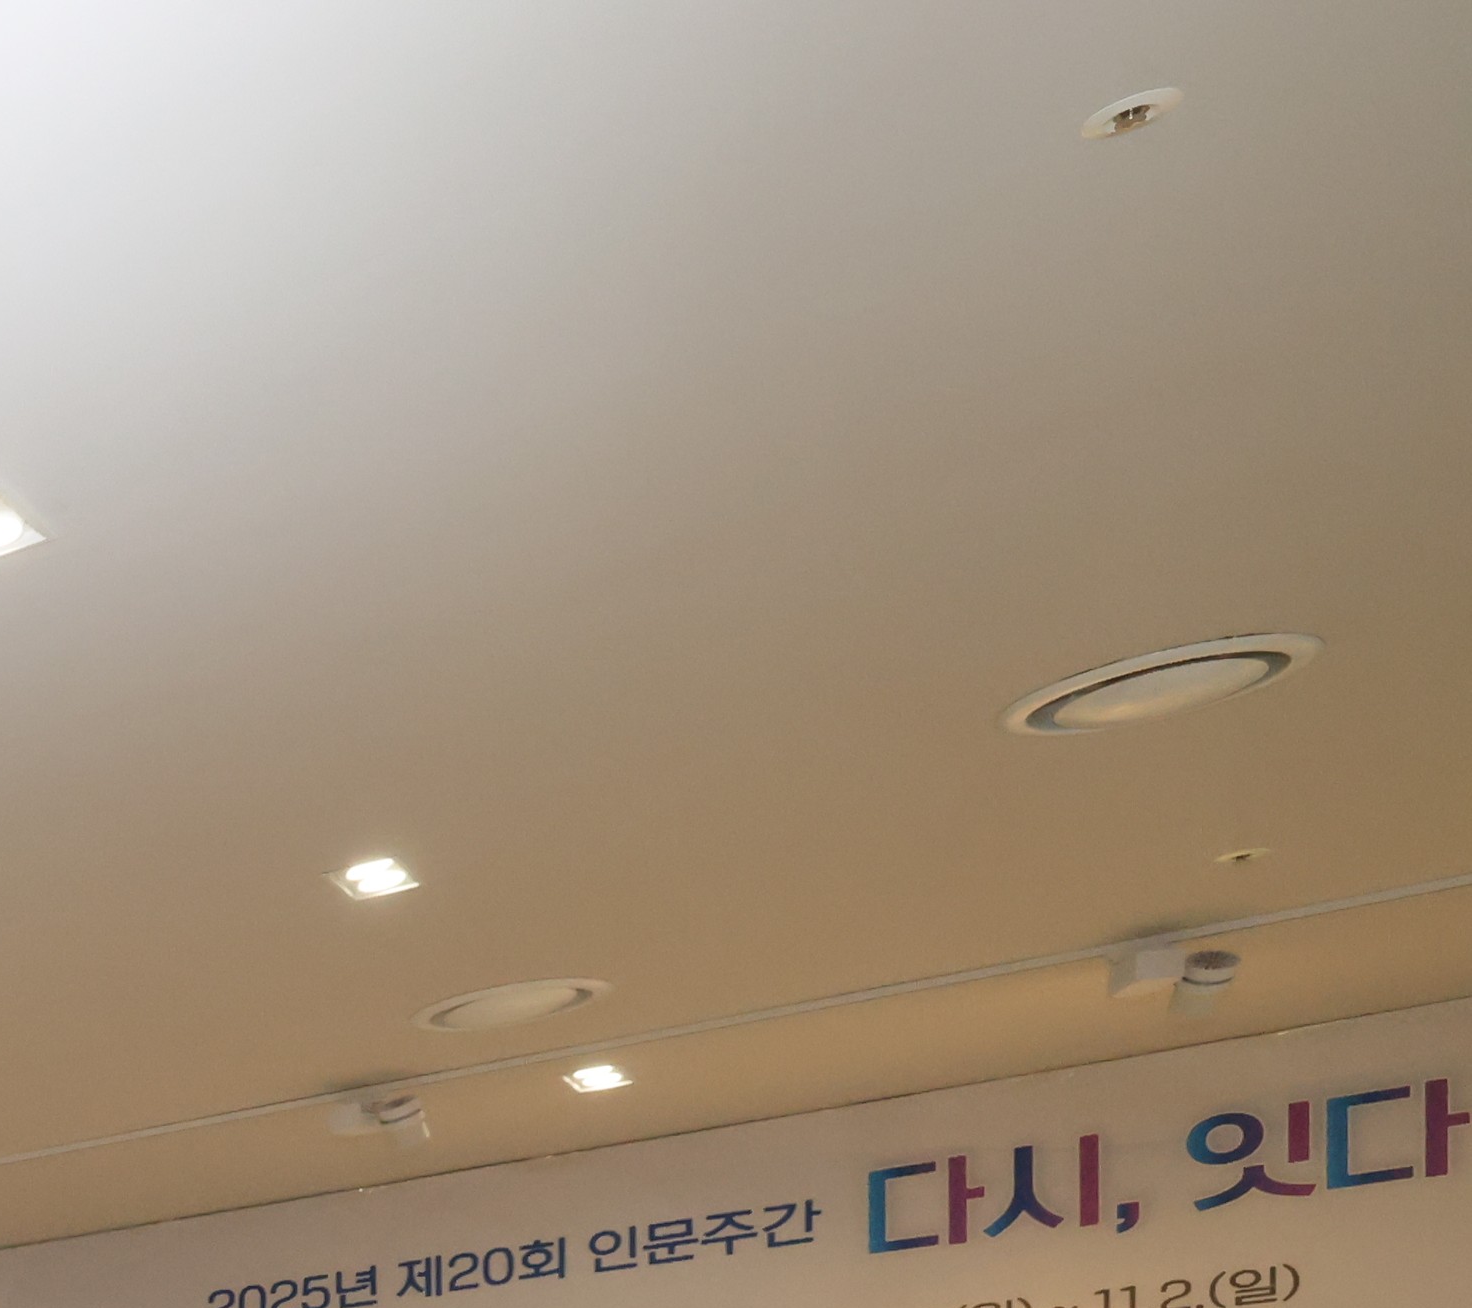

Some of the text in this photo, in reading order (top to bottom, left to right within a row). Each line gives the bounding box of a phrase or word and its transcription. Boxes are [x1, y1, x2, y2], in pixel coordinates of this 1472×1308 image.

[867, 1077, 1471, 1254] 다시, 잇다
[396, 1237, 566, 1298] 제20회
[588, 1200, 821, 1273] 인문주간
